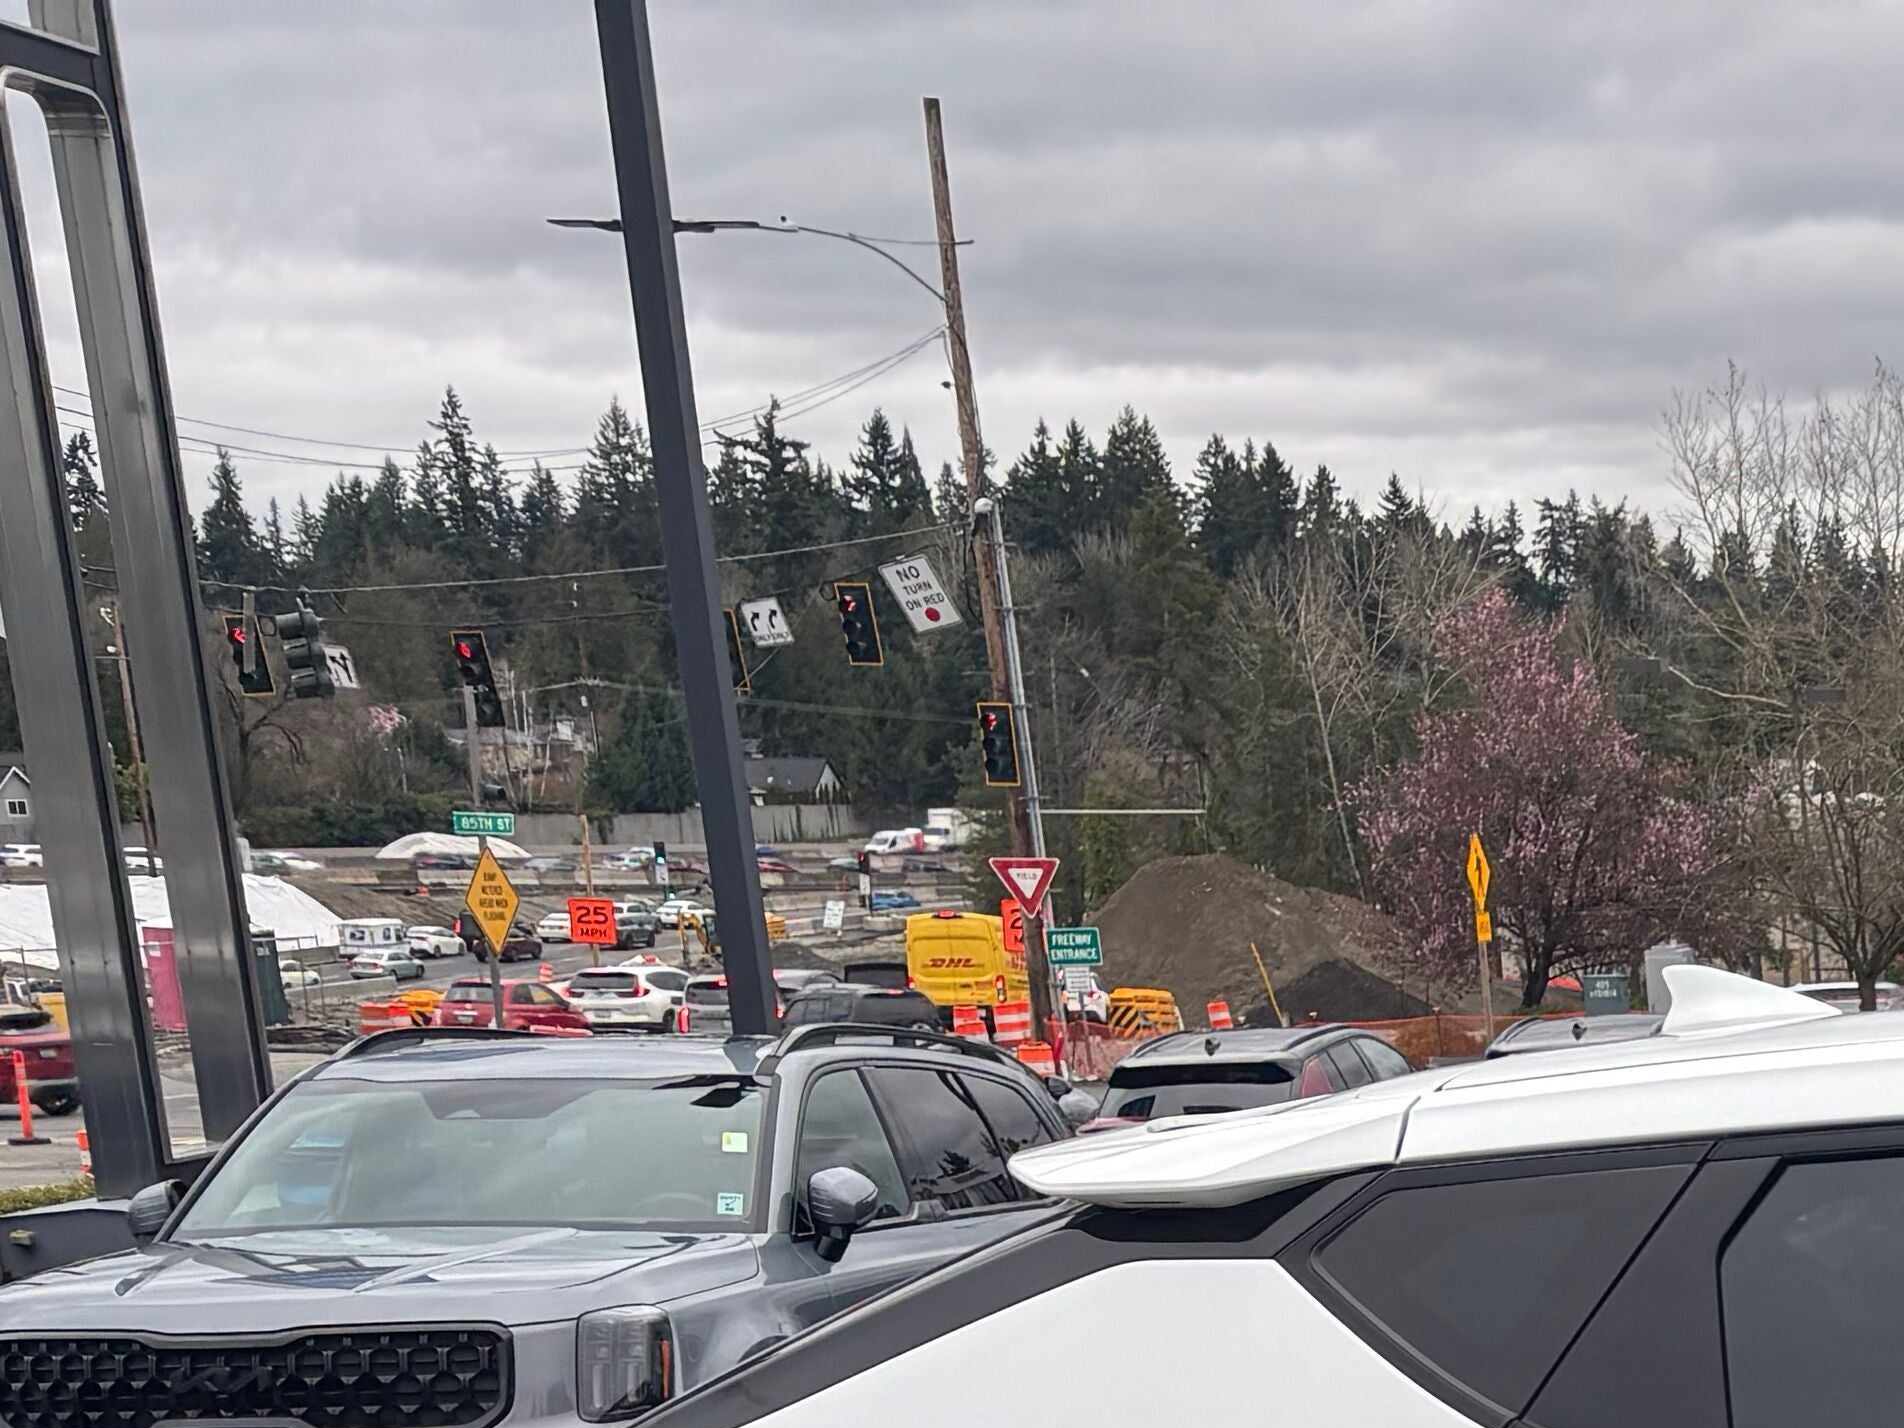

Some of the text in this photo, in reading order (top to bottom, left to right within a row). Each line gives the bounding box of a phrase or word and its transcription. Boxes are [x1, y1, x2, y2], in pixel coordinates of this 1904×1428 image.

[895, 565, 920, 583] NO
[903, 580, 932, 596] TURN
[905, 592, 945, 611] ON RED
[461, 816, 511, 831] 85TH ST
[1017, 873, 1037, 881] YIELD
[575, 905, 609, 925] 25
[1010, 908, 1023, 930] 2
[580, 927, 607, 938] MPH
[1051, 933, 1092, 946] FREEWAY
[1051, 948, 1098, 961] ENTRANCE
[928, 957, 977, 969] DHL
